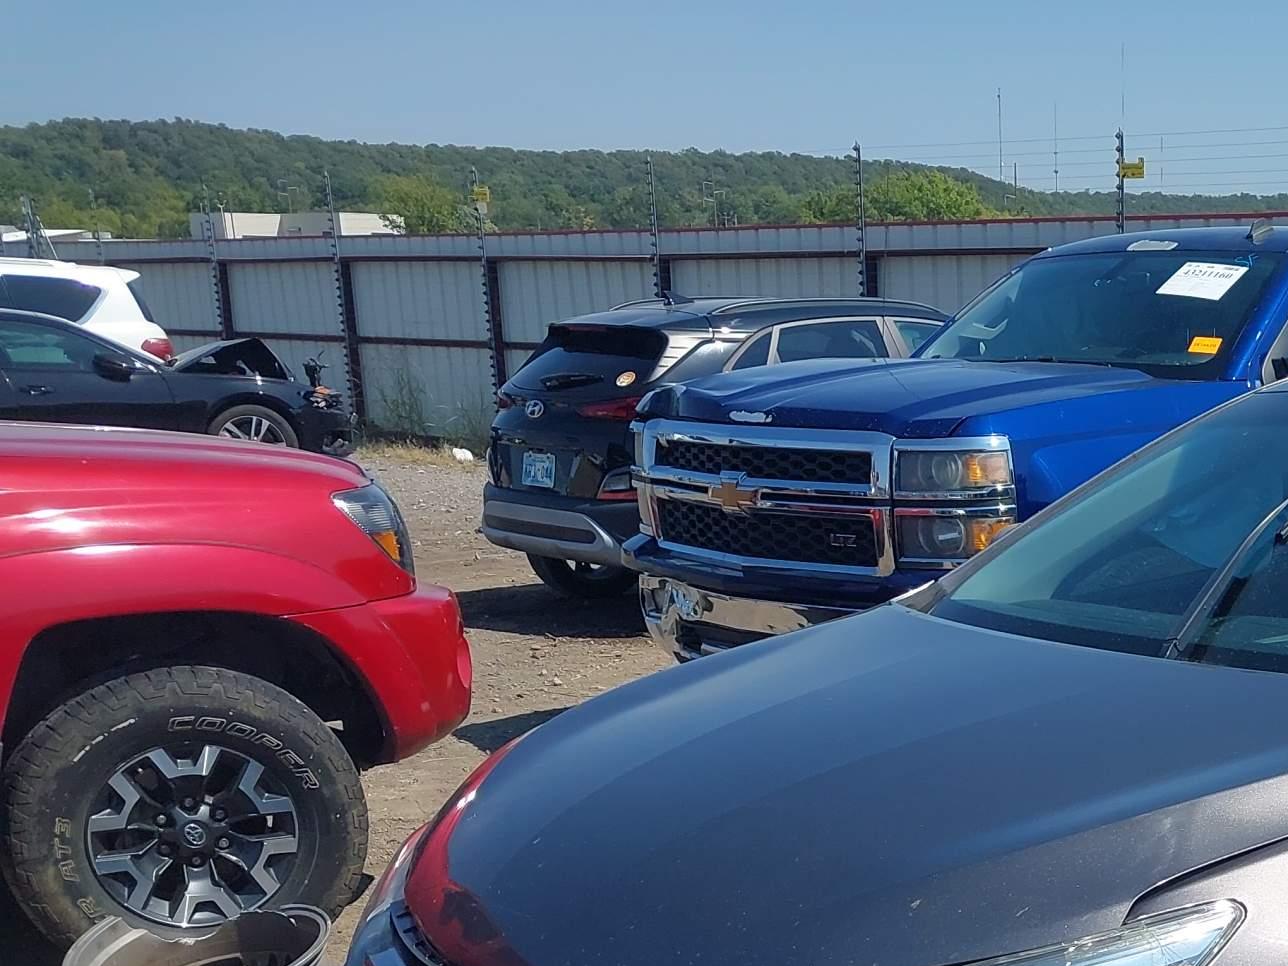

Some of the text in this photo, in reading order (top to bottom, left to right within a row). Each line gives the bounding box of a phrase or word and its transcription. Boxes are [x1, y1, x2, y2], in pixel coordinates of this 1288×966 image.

[831, 533, 857, 547] LTZ
[167, 714, 320, 792] COOPER
[54, 815, 81, 883] AT3
